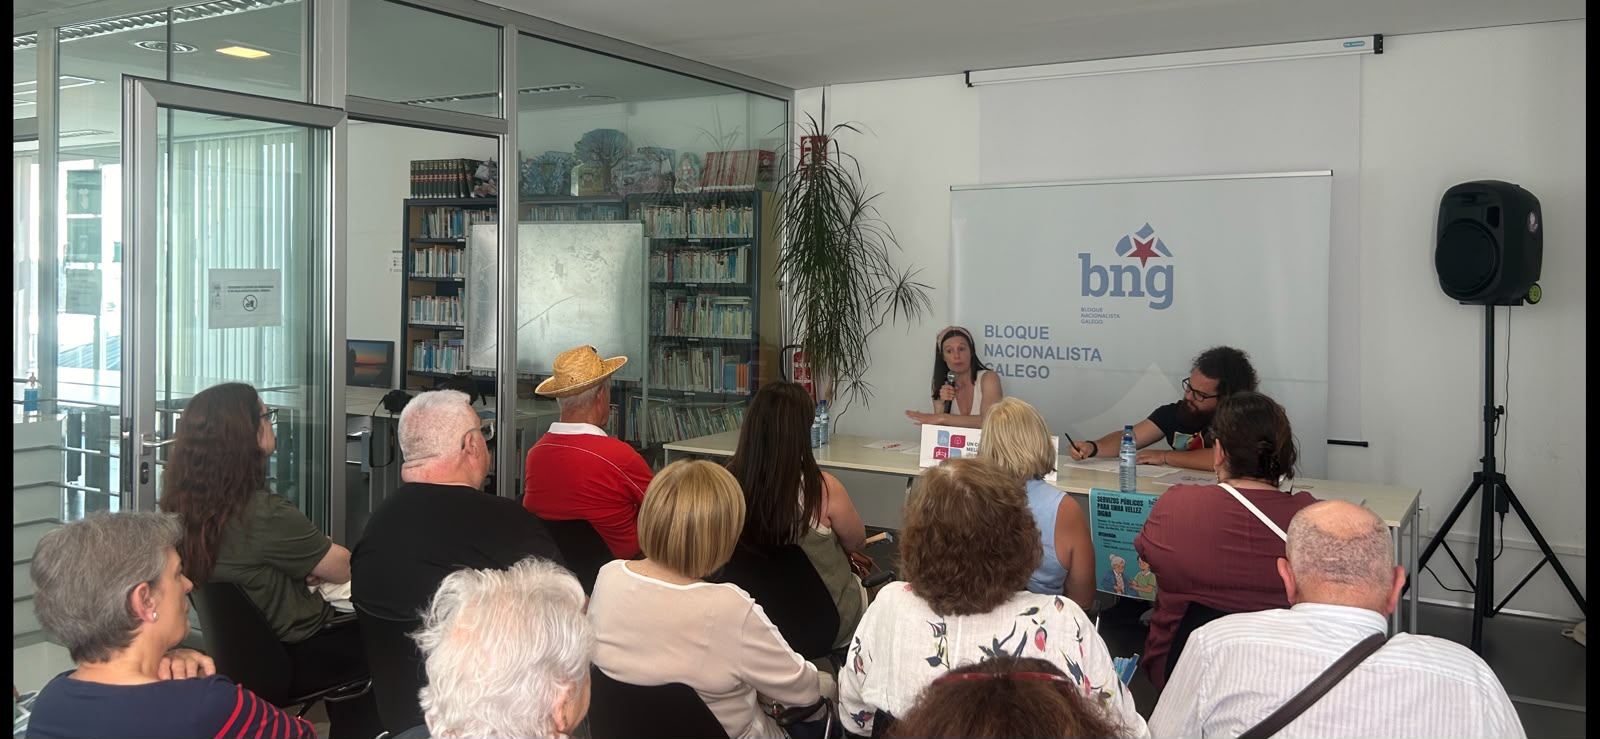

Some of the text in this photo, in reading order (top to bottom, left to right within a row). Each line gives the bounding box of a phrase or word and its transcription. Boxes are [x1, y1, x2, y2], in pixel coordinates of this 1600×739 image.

[1078, 253, 1174, 310] bng
[984, 324, 1050, 340] BLOQUE
[984, 343, 1103, 363] NACIONALISTA
[1097, 496, 1143, 506] SERVIZOS PÚBLICOS
